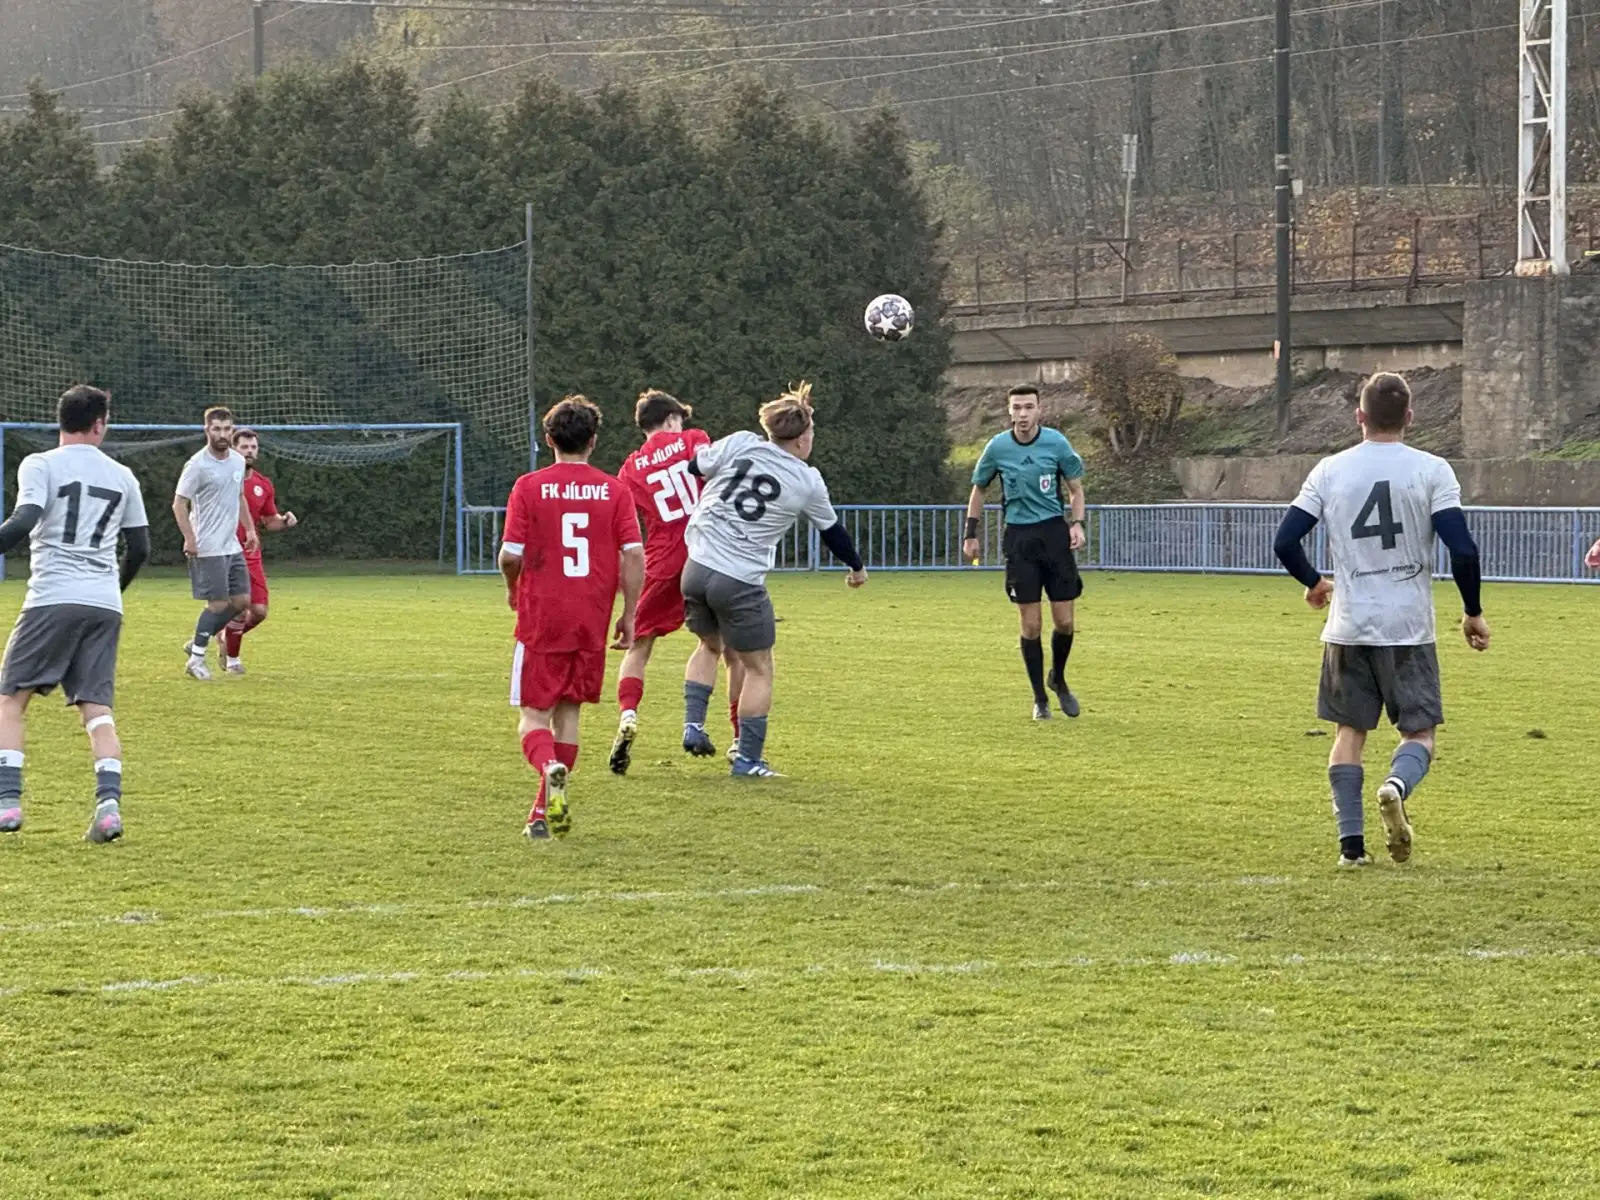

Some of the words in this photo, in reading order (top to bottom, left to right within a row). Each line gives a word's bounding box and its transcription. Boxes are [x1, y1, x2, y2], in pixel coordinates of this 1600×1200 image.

[634, 454, 649, 471] FK
[650, 437, 687, 465] JÍLOVÉ
[57, 480, 123, 549] 17
[541, 483, 560, 500] FK
[562, 481, 610, 501] JÍLOVÉ
[646, 459, 699, 523] 20
[719, 458, 781, 522] 18
[1350, 480, 1404, 551] 4
[561, 512, 590, 577] 5
